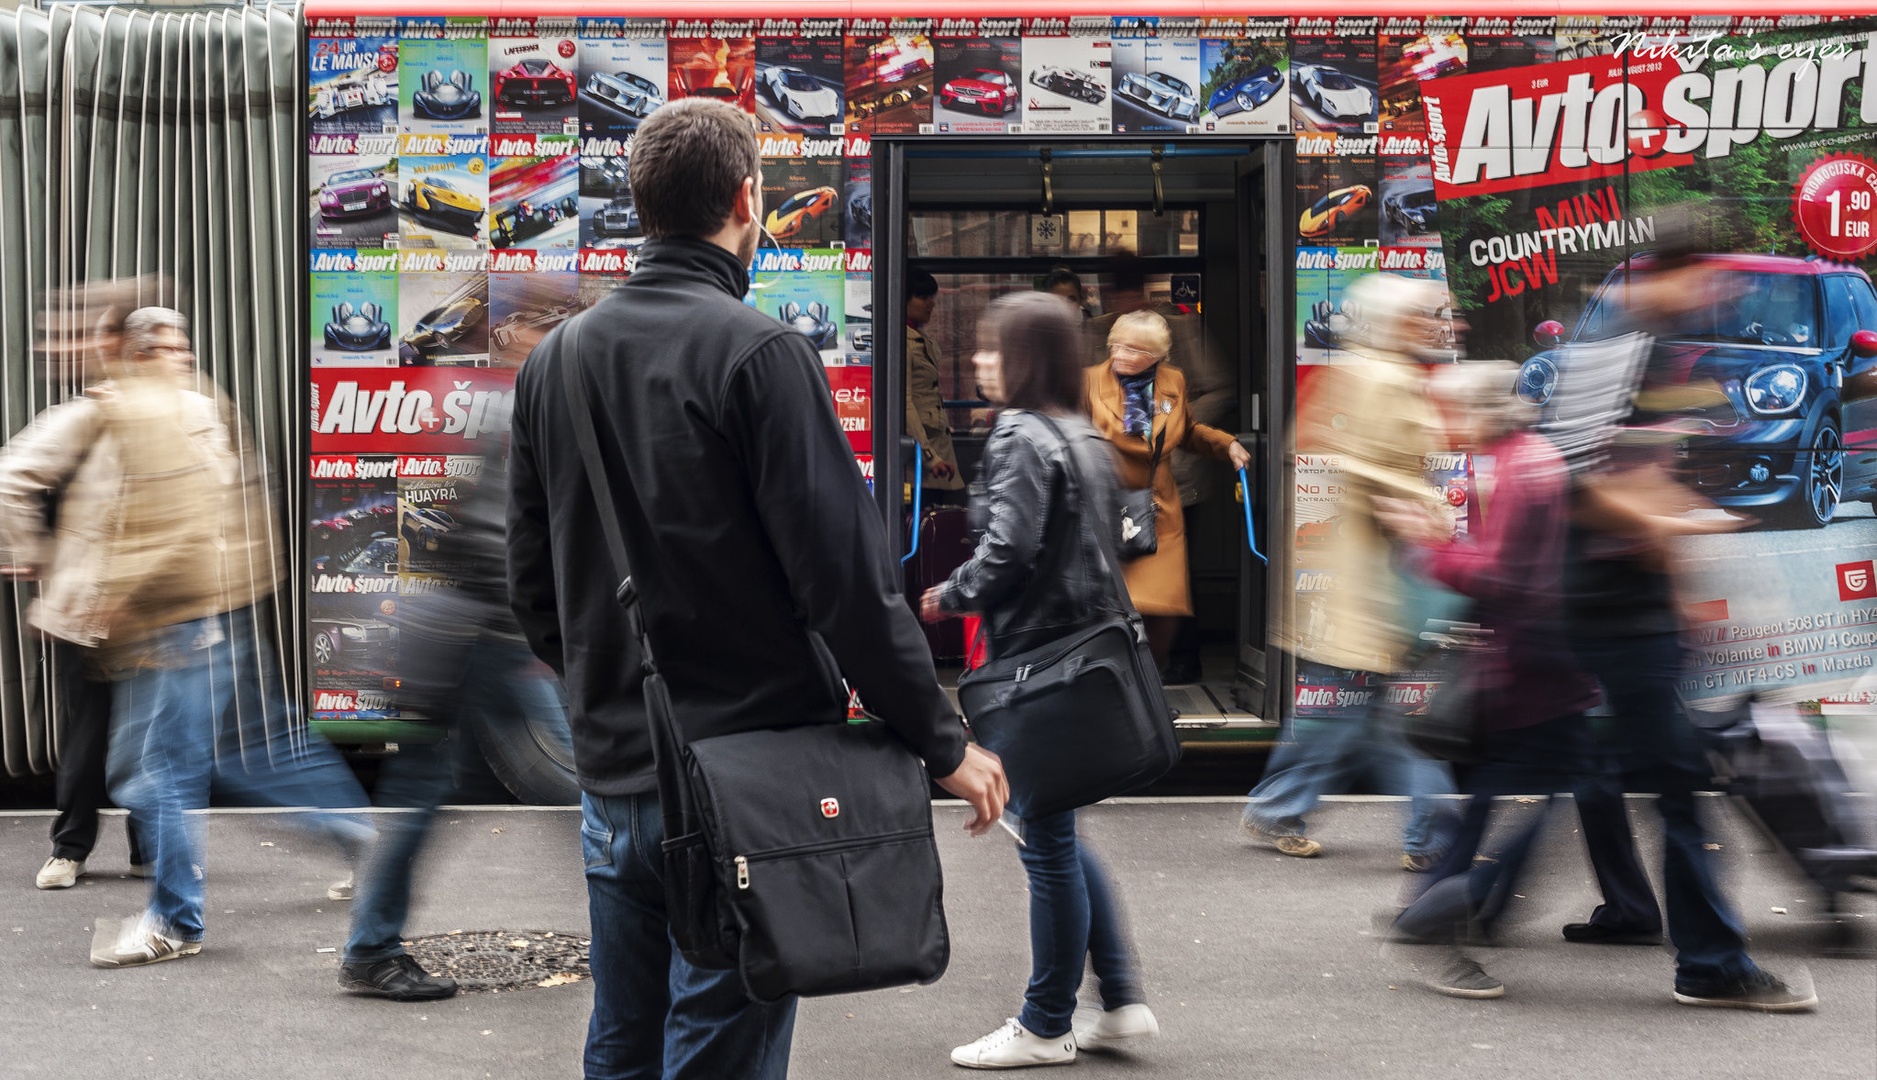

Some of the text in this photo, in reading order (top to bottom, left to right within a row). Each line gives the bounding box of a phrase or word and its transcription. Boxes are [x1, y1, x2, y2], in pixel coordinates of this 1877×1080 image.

[316, 41, 356, 57] 24 UR
[312, 51, 380, 71] LE MANSA
[1531, 79, 1549, 89] 3 EUR
[1451, 73, 1643, 186] Avto
[318, 136, 351, 153] Avto
[405, 136, 441, 154] Avto
[498, 138, 532, 155] Avto
[762, 136, 797, 156] Avto
[851, 137, 871, 156] Av
[1296, 136, 1331, 154] Avto
[1802, 162, 1877, 202] PROMOCIJSKA CE
[1535, 186, 1622, 242] MINI
[1845, 220, 1870, 238] EUR
[1469, 216, 1656, 266] COUNTRYMAN
[315, 253, 349, 271] Avto
[403, 253, 441, 271] Avto
[496, 253, 532, 271] Avto
[762, 252, 798, 271] Avto
[851, 252, 872, 271] Av
[1296, 251, 1331, 270] Avto
[1488, 248, 1559, 303] JCW
[831, 386, 866, 403] et
[319, 381, 432, 434] Avto
[840, 417, 866, 432] ZEM
[315, 459, 351, 477] Avto
[444, 459, 482, 477] špor
[404, 487, 458, 503] HUAYRA
[316, 575, 350, 593] Avto
[1731, 620, 1784, 641] Peugeot
[1787, 615, 1813, 633] 508
[1814, 612, 1834, 629] GT
[1836, 610, 1849, 625] in
[1704, 643, 1764, 666] Volante
[1767, 642, 1781, 658] in
[1783, 634, 1826, 656] BMW
[1828, 633, 1839, 649] 4
[1841, 628, 1877, 648] Coup
[1704, 671, 1726, 689] GT
[1731, 663, 1797, 686] MF4-CS
[1801, 660, 1816, 675] in
[1822, 652, 1873, 674] Mazda
